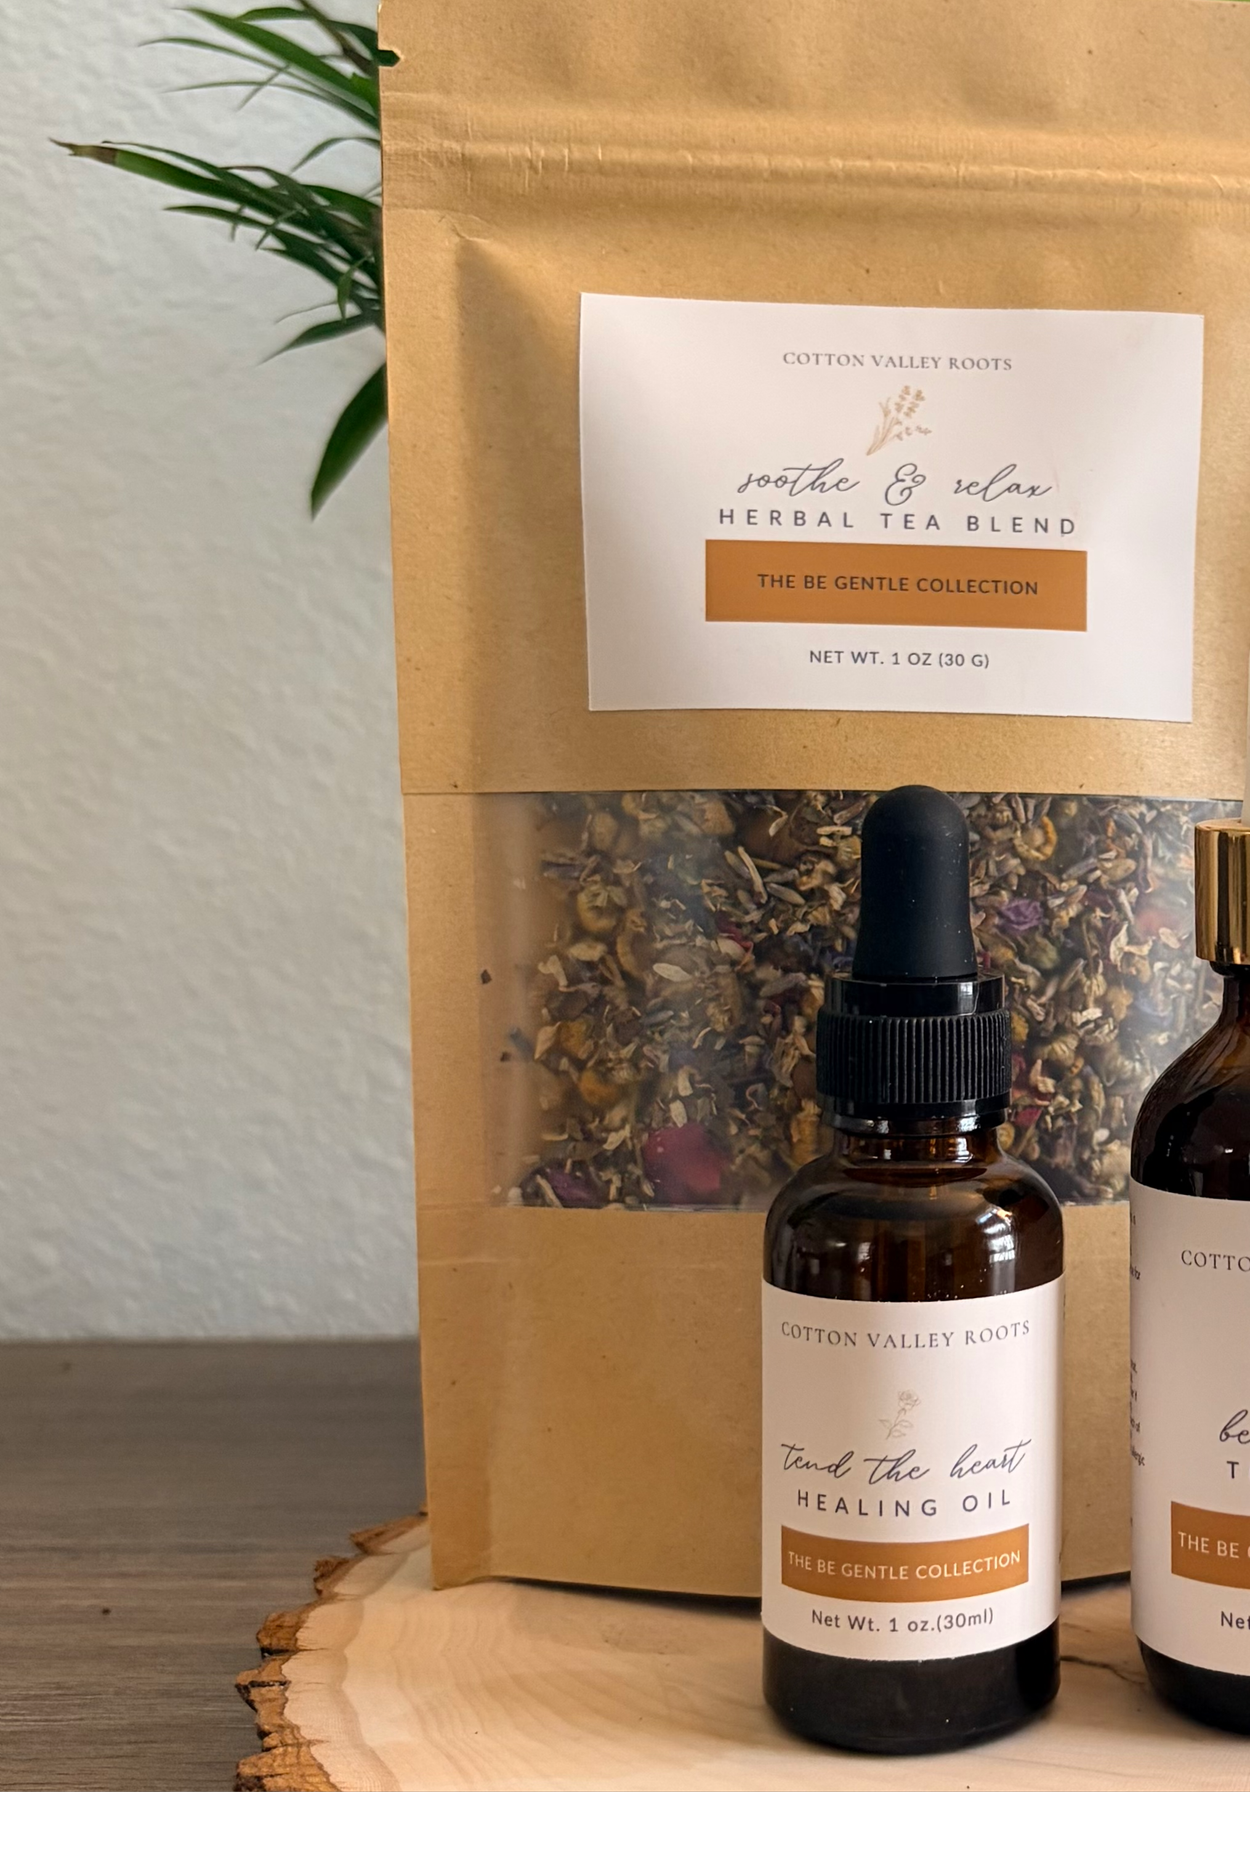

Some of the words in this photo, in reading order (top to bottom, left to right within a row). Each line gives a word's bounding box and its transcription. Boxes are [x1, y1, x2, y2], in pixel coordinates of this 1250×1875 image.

[783, 351, 865, 368] COTTON
[870, 354, 942, 370] VALLEY
[948, 355, 1013, 371] ROOTS
[737, 458, 860, 495] soothe
[885, 463, 926, 506] &
[954, 464, 1054, 502] relax
[719, 508, 854, 530] HERBAL
[880, 512, 941, 531] TEA
[967, 515, 1076, 536] BLEND
[758, 573, 796, 589] THE
[803, 573, 827, 590] BE
[834, 575, 909, 593] GENTLE
[916, 576, 1039, 596] COLLECTION
[810, 650, 844, 665] NET
[850, 650, 884, 666] WT.
[892, 651, 901, 666] 1
[908, 652, 932, 667] OZ
[938, 651, 966, 669] (30
[971, 652, 990, 670] G)
[782, 1321, 857, 1347] COTTON
[867, 1331, 955, 1349] VALLEY
[965, 1320, 1030, 1346] ROOTS
[781, 1443, 854, 1479] tend
[863, 1449, 930, 1485] the
[949, 1438, 1032, 1479] heart
[798, 1489, 937, 1517] HEALING
[962, 1489, 1010, 1513] OIL
[1178, 1531, 1209, 1553] THE
[1217, 1540, 1239, 1558] BE
[788, 1551, 811, 1570] THE
[817, 1559, 835, 1575] BE
[841, 1563, 909, 1580] GENTLE
[916, 1550, 1021, 1580] COLLECTION
[812, 1610, 840, 1629] Net
[849, 1614, 880, 1633] Wt.
[889, 1618, 899, 1633] 1
